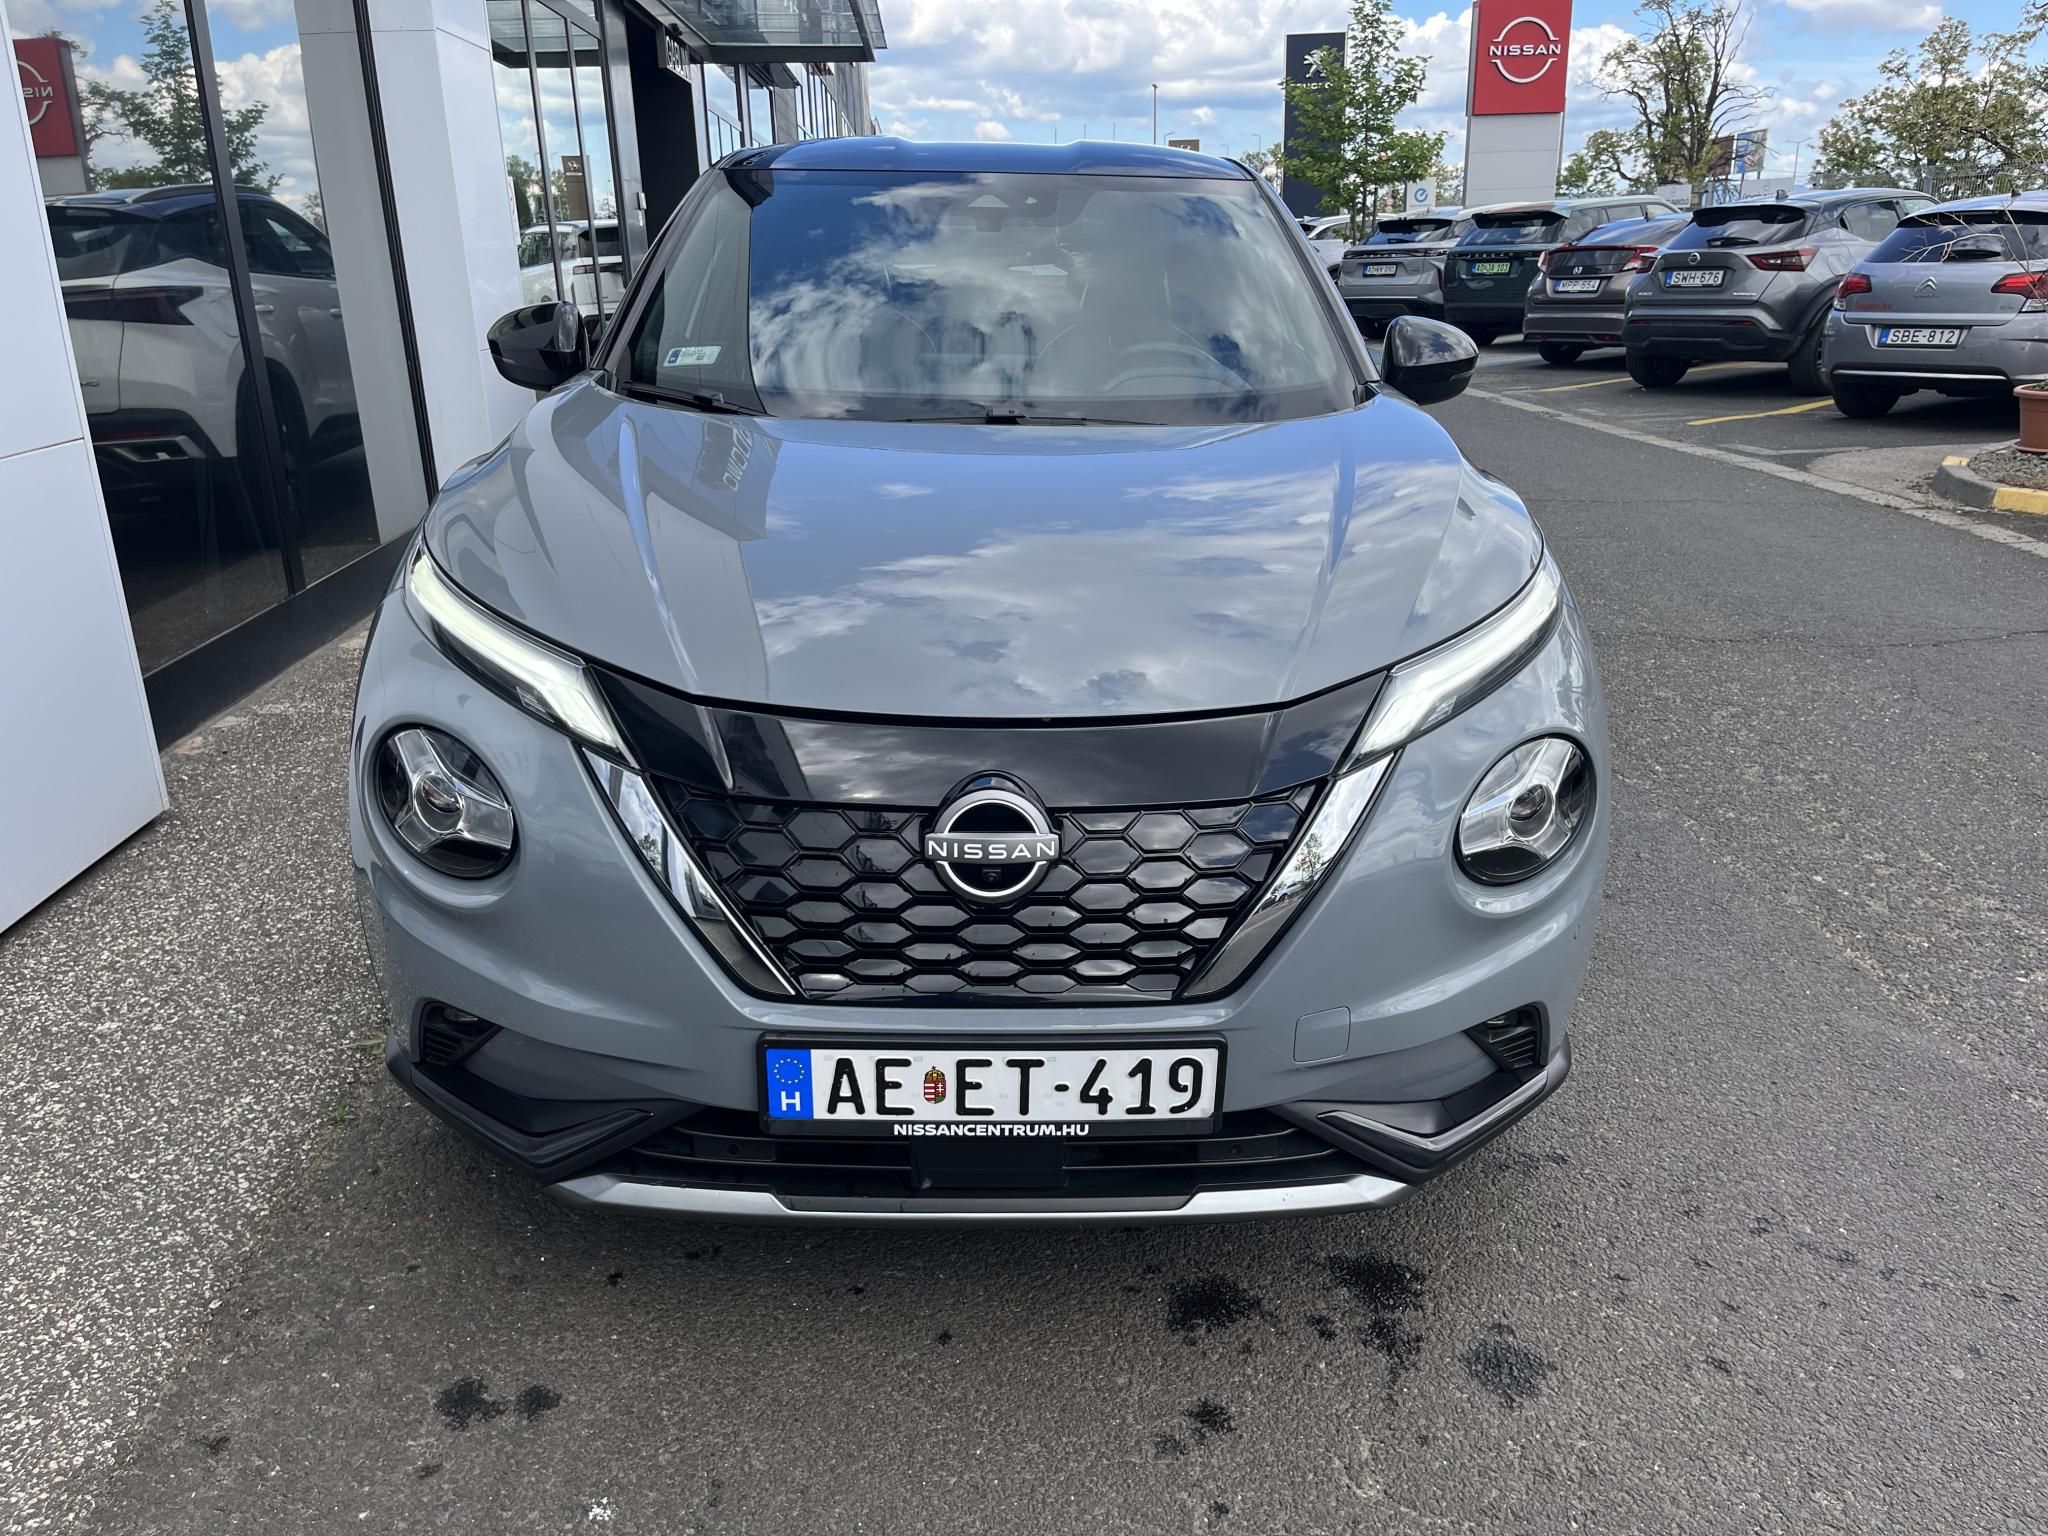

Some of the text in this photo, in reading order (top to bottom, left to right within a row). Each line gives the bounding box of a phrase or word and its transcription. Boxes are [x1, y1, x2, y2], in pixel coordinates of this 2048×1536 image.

[1489, 43, 1561, 56] NISSAN
[1673, 271, 1720, 284] SWH-676
[1890, 329, 1956, 344] SBE-812
[928, 840, 1056, 860] NISSAN
[827, 1057, 1204, 1116] AE ET-419
[781, 1091, 801, 1112] H
[893, 1123, 1090, 1137] NISSANCENTRUM.HU
